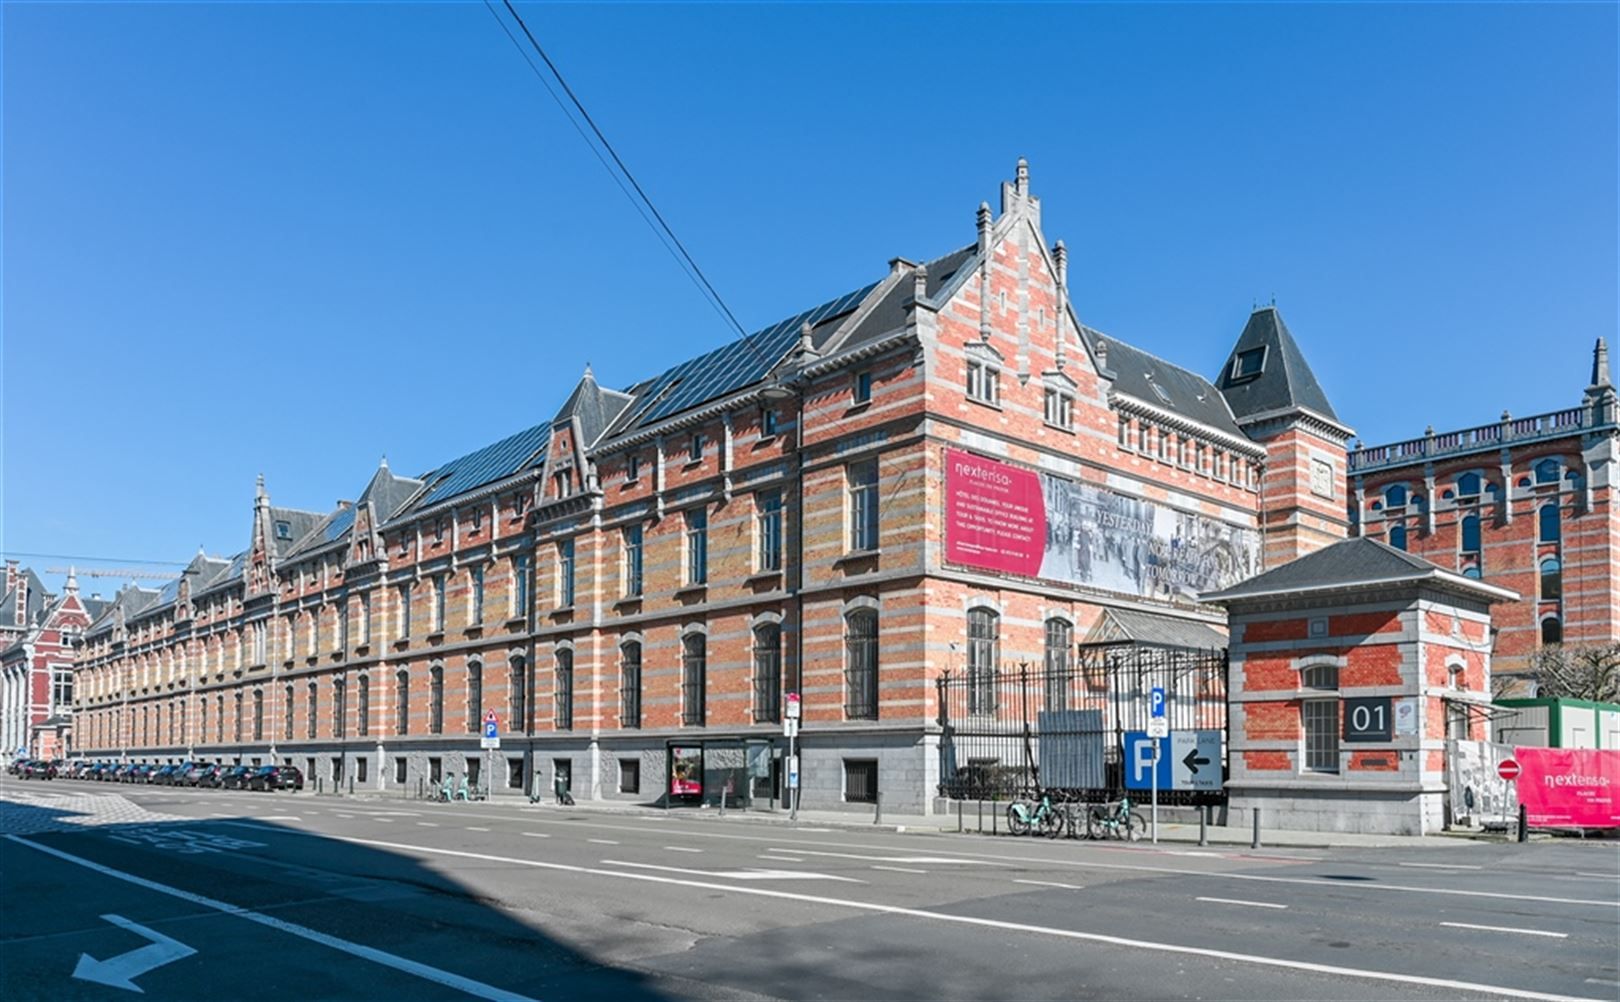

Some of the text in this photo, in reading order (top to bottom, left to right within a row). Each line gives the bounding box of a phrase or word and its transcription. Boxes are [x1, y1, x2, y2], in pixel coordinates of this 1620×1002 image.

[1153, 692, 1163, 713] P
[1352, 705, 1384, 731] 01
[487, 724, 495, 736] P
[1134, 739, 1161, 781] P
